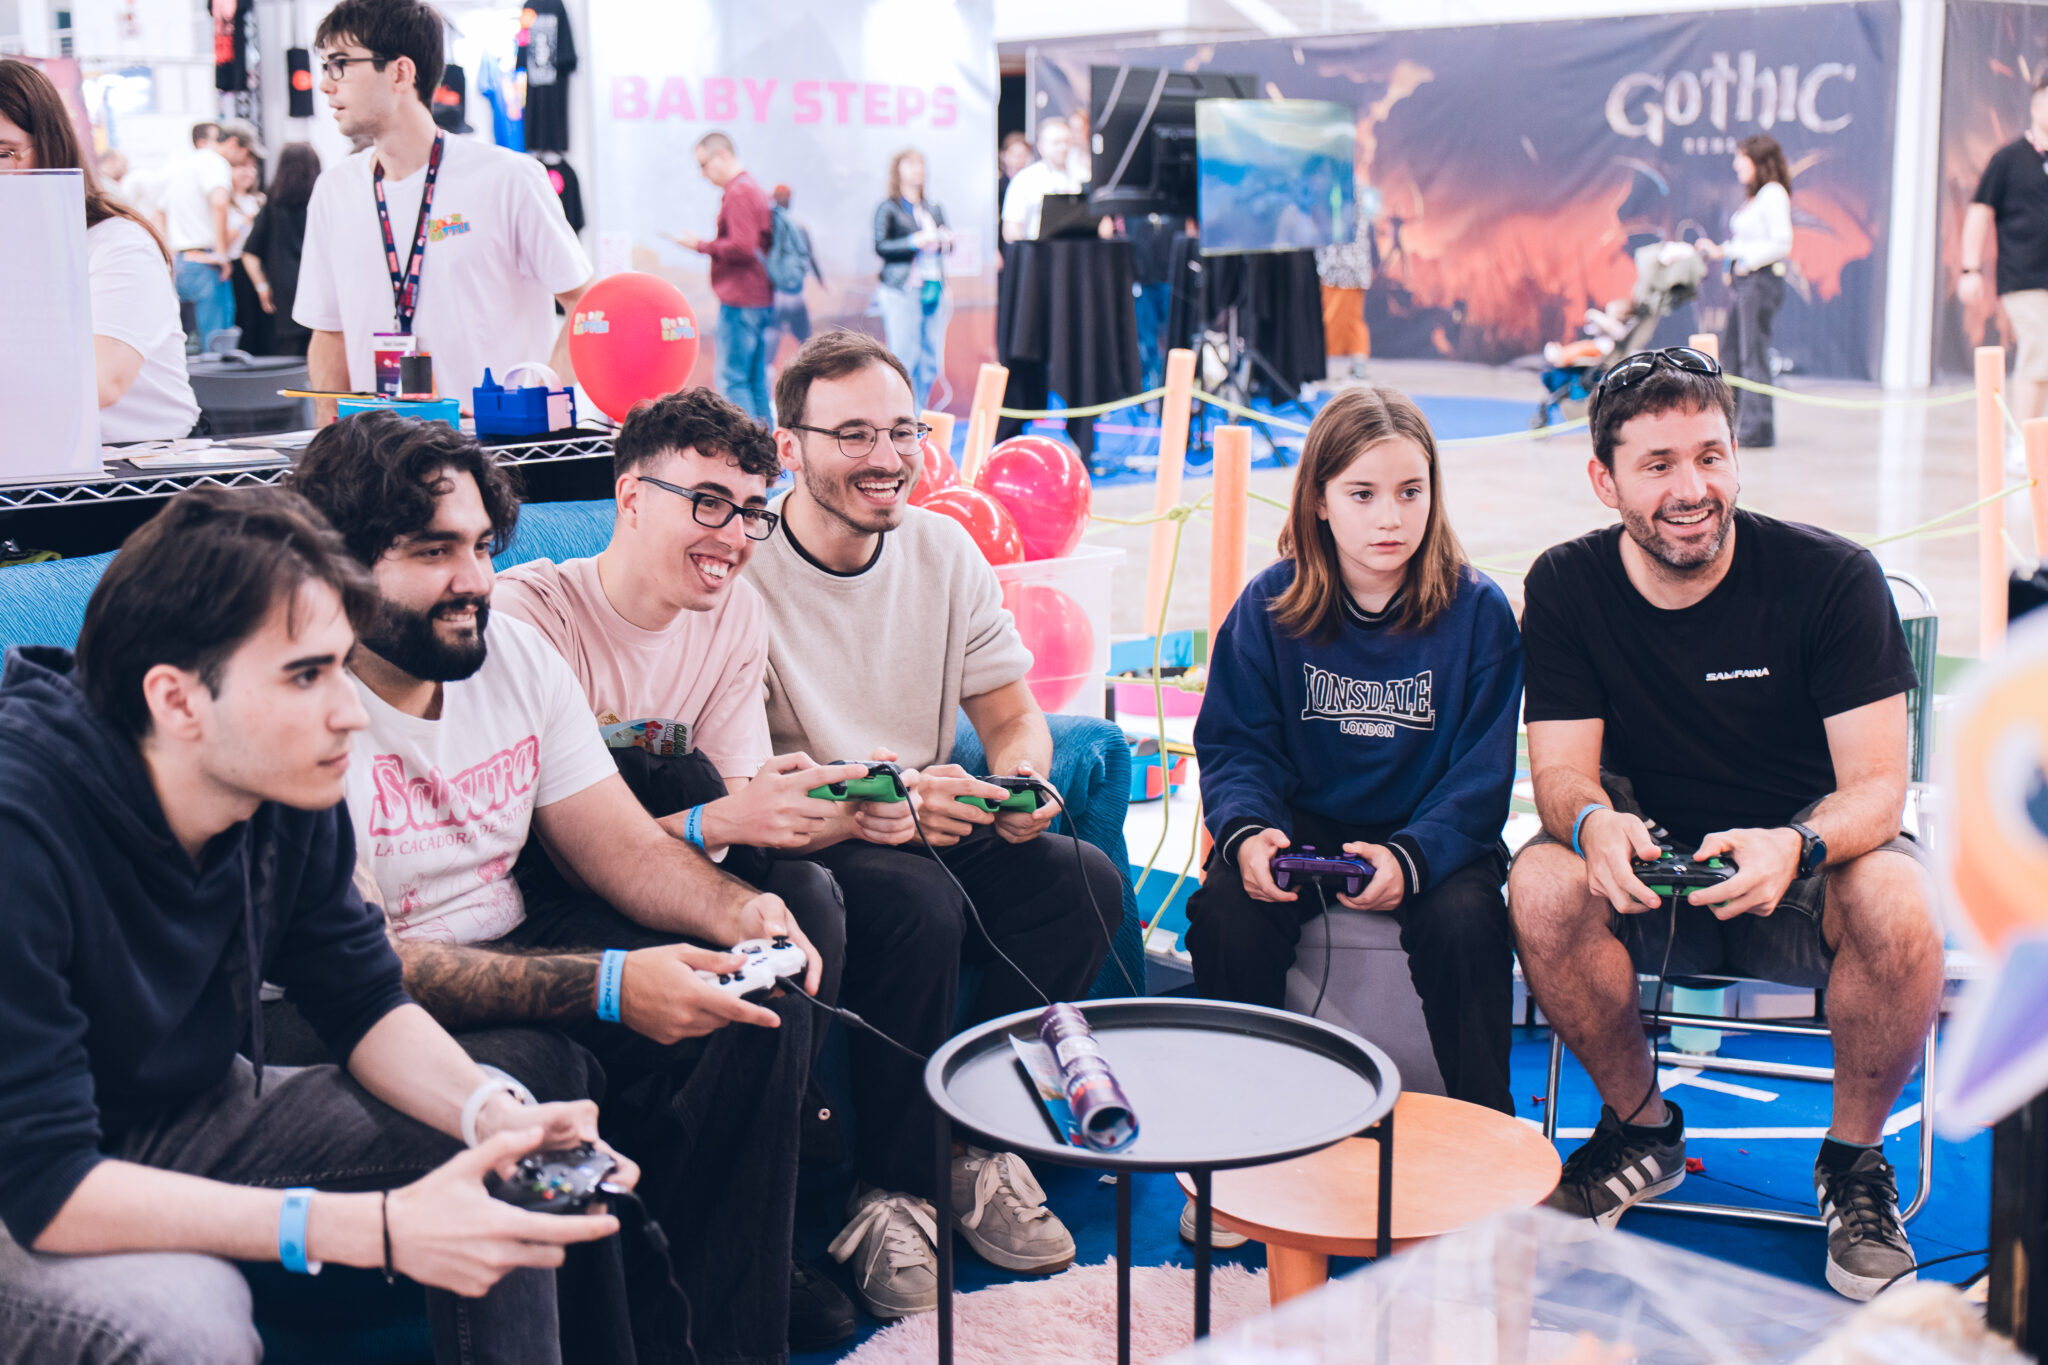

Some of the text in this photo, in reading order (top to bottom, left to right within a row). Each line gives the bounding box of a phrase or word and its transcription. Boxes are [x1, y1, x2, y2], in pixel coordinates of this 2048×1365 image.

[612, 75, 958, 127] BABY STEPS
[1302, 662, 1436, 730] LONSDALE
[1340, 720, 1395, 738] LONDON
[375, 843, 395, 857] LA
[479, 824, 497, 835] DE
